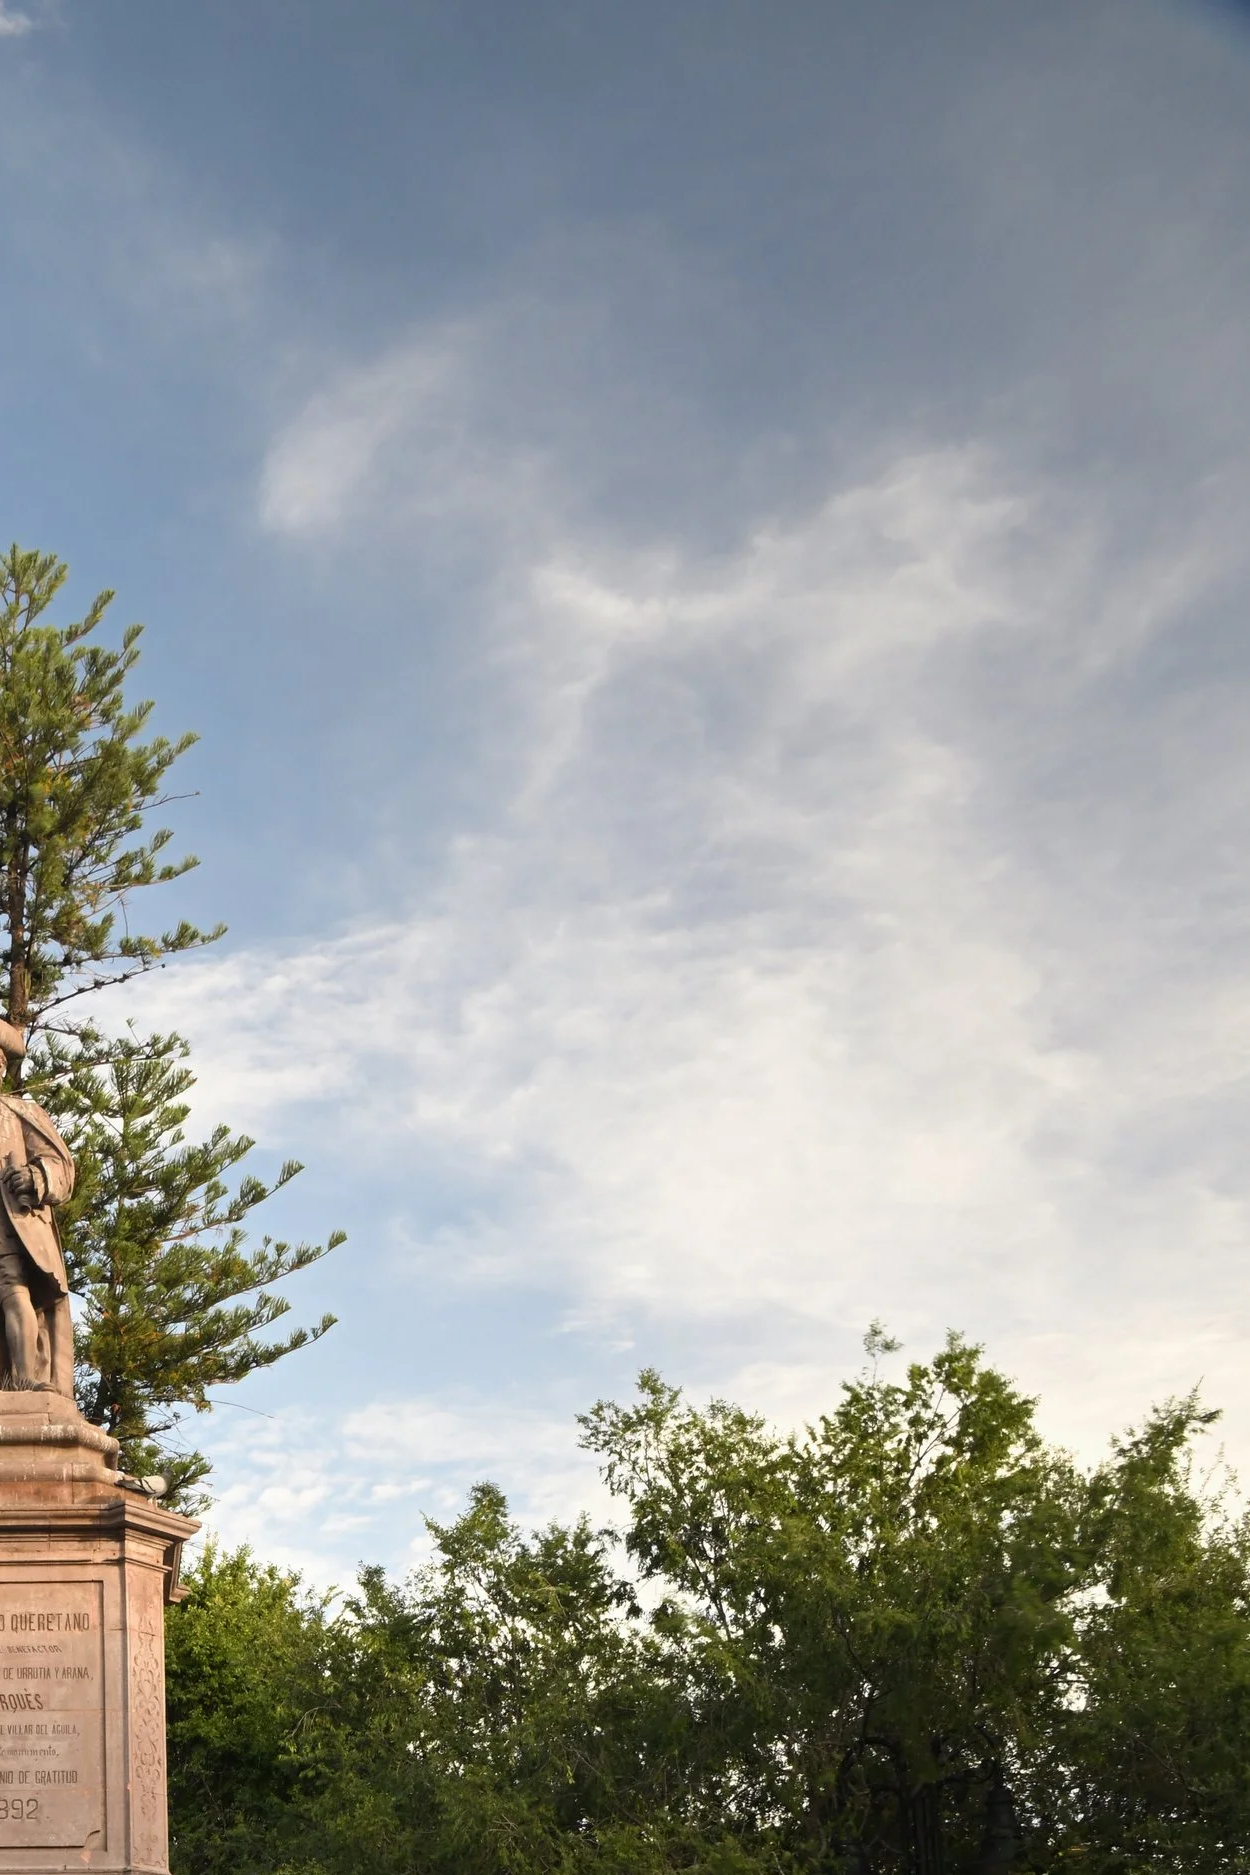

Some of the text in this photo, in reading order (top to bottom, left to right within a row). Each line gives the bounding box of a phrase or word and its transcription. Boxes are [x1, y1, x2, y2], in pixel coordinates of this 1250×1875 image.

[10, 1613, 90, 1633] QUERETANO
[6, 1645, 63, 1654] BENEFACTOR
[3, 1667, 14, 1680] DE
[17, 1667, 51, 1680] URRUTIA
[54, 1667, 60, 1680] Y
[7, 1724, 33, 1736] VILLAR
[35, 1724, 48, 1736] DEL
[18, 1770, 30, 1784] DE
[35, 1770, 78, 1785] GRATITUD
